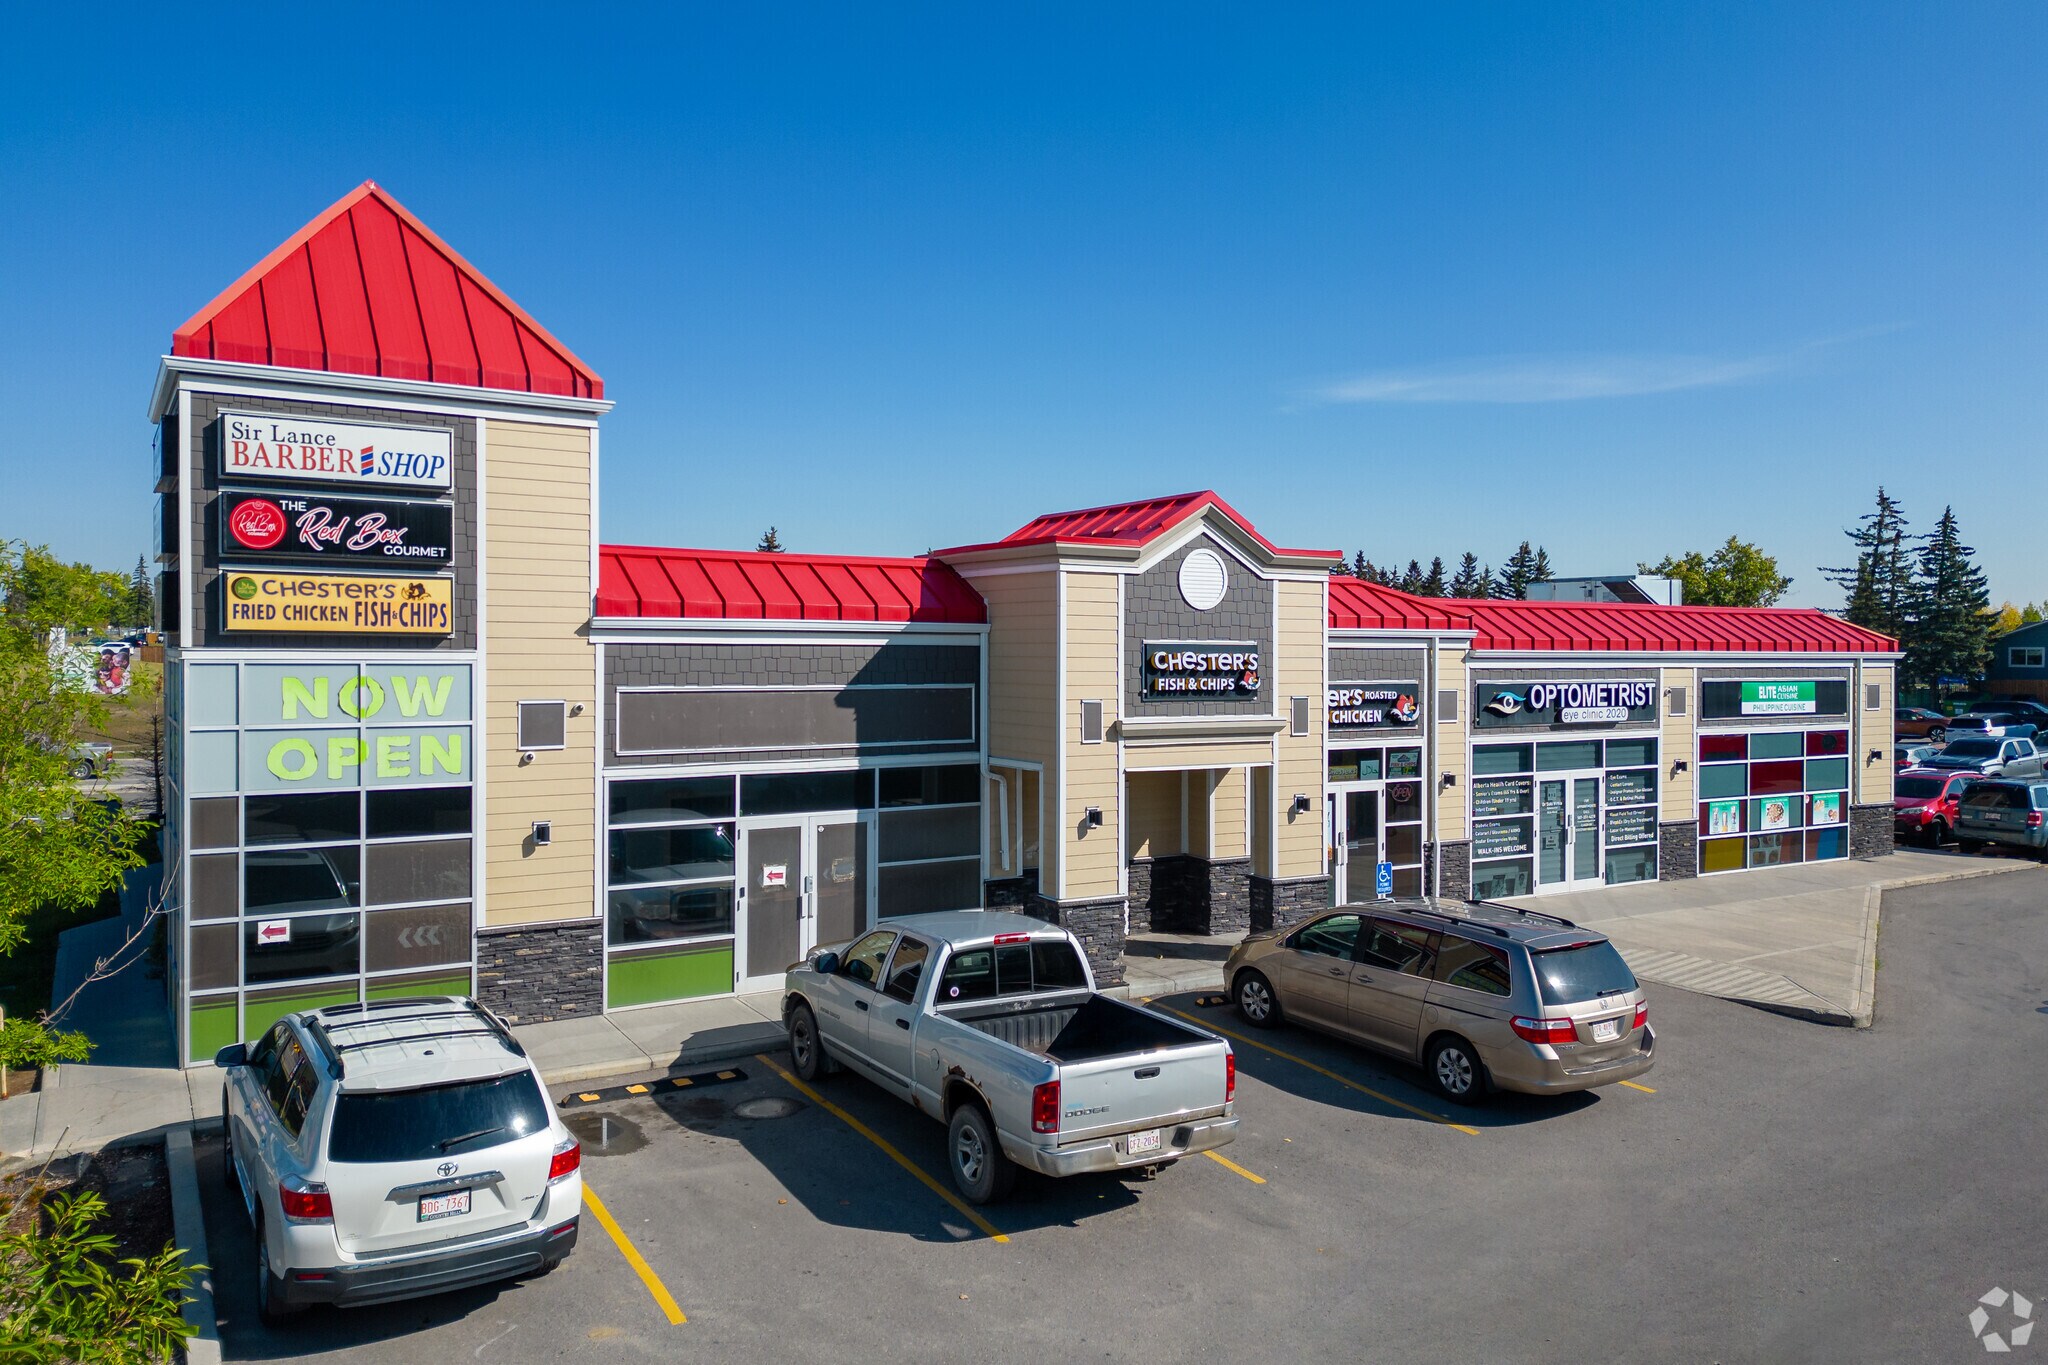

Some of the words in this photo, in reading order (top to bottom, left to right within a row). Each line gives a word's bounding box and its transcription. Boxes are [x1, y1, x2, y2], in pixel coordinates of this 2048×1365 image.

[231, 421, 262, 441] Sir
[270, 424, 336, 446] Lance
[231, 440, 358, 474] BARBER
[377, 451, 445, 479] SHOP
[279, 500, 308, 512] THE
[296, 506, 350, 551] Red
[347, 512, 408, 551] Box
[383, 545, 447, 558] GOURMET
[232, 603, 276, 620] FRIED
[283, 604, 348, 622] CHICKEN
[354, 601, 391, 627] FISH
[398, 602, 447, 628] CHIPS
[1158, 678, 1186, 691] FISH
[1188, 678, 1197, 690] &
[1200, 678, 1235, 691] CHIPS
[281, 674, 455, 720] NOW
[1364, 691, 1398, 700] ROASTED
[1530, 682, 1656, 709] OPTOMETRIST
[1758, 685, 1777, 699] ELITE
[1777, 692, 1798, 700] CUISINE
[1563, 709, 1579, 720] eye
[1581, 708, 1603, 719] clinic
[1606, 707, 1627, 719] 2020
[1752, 704, 1783, 712] PHILIPPINE
[1784, 703, 1806, 712] CUISINE
[1332, 709, 1382, 724] CHICKEN
[266, 734, 463, 781] OPEN
[1393, 787, 1412, 797] OPEN
[1624, 833, 1638, 841] Billing
[1477, 846, 1502, 855] WALK-INS
[1503, 844, 1527, 853] WELCOME
[1065, 1104, 1111, 1118] DODGE
[421, 1195, 469, 1215] BDG-7367
